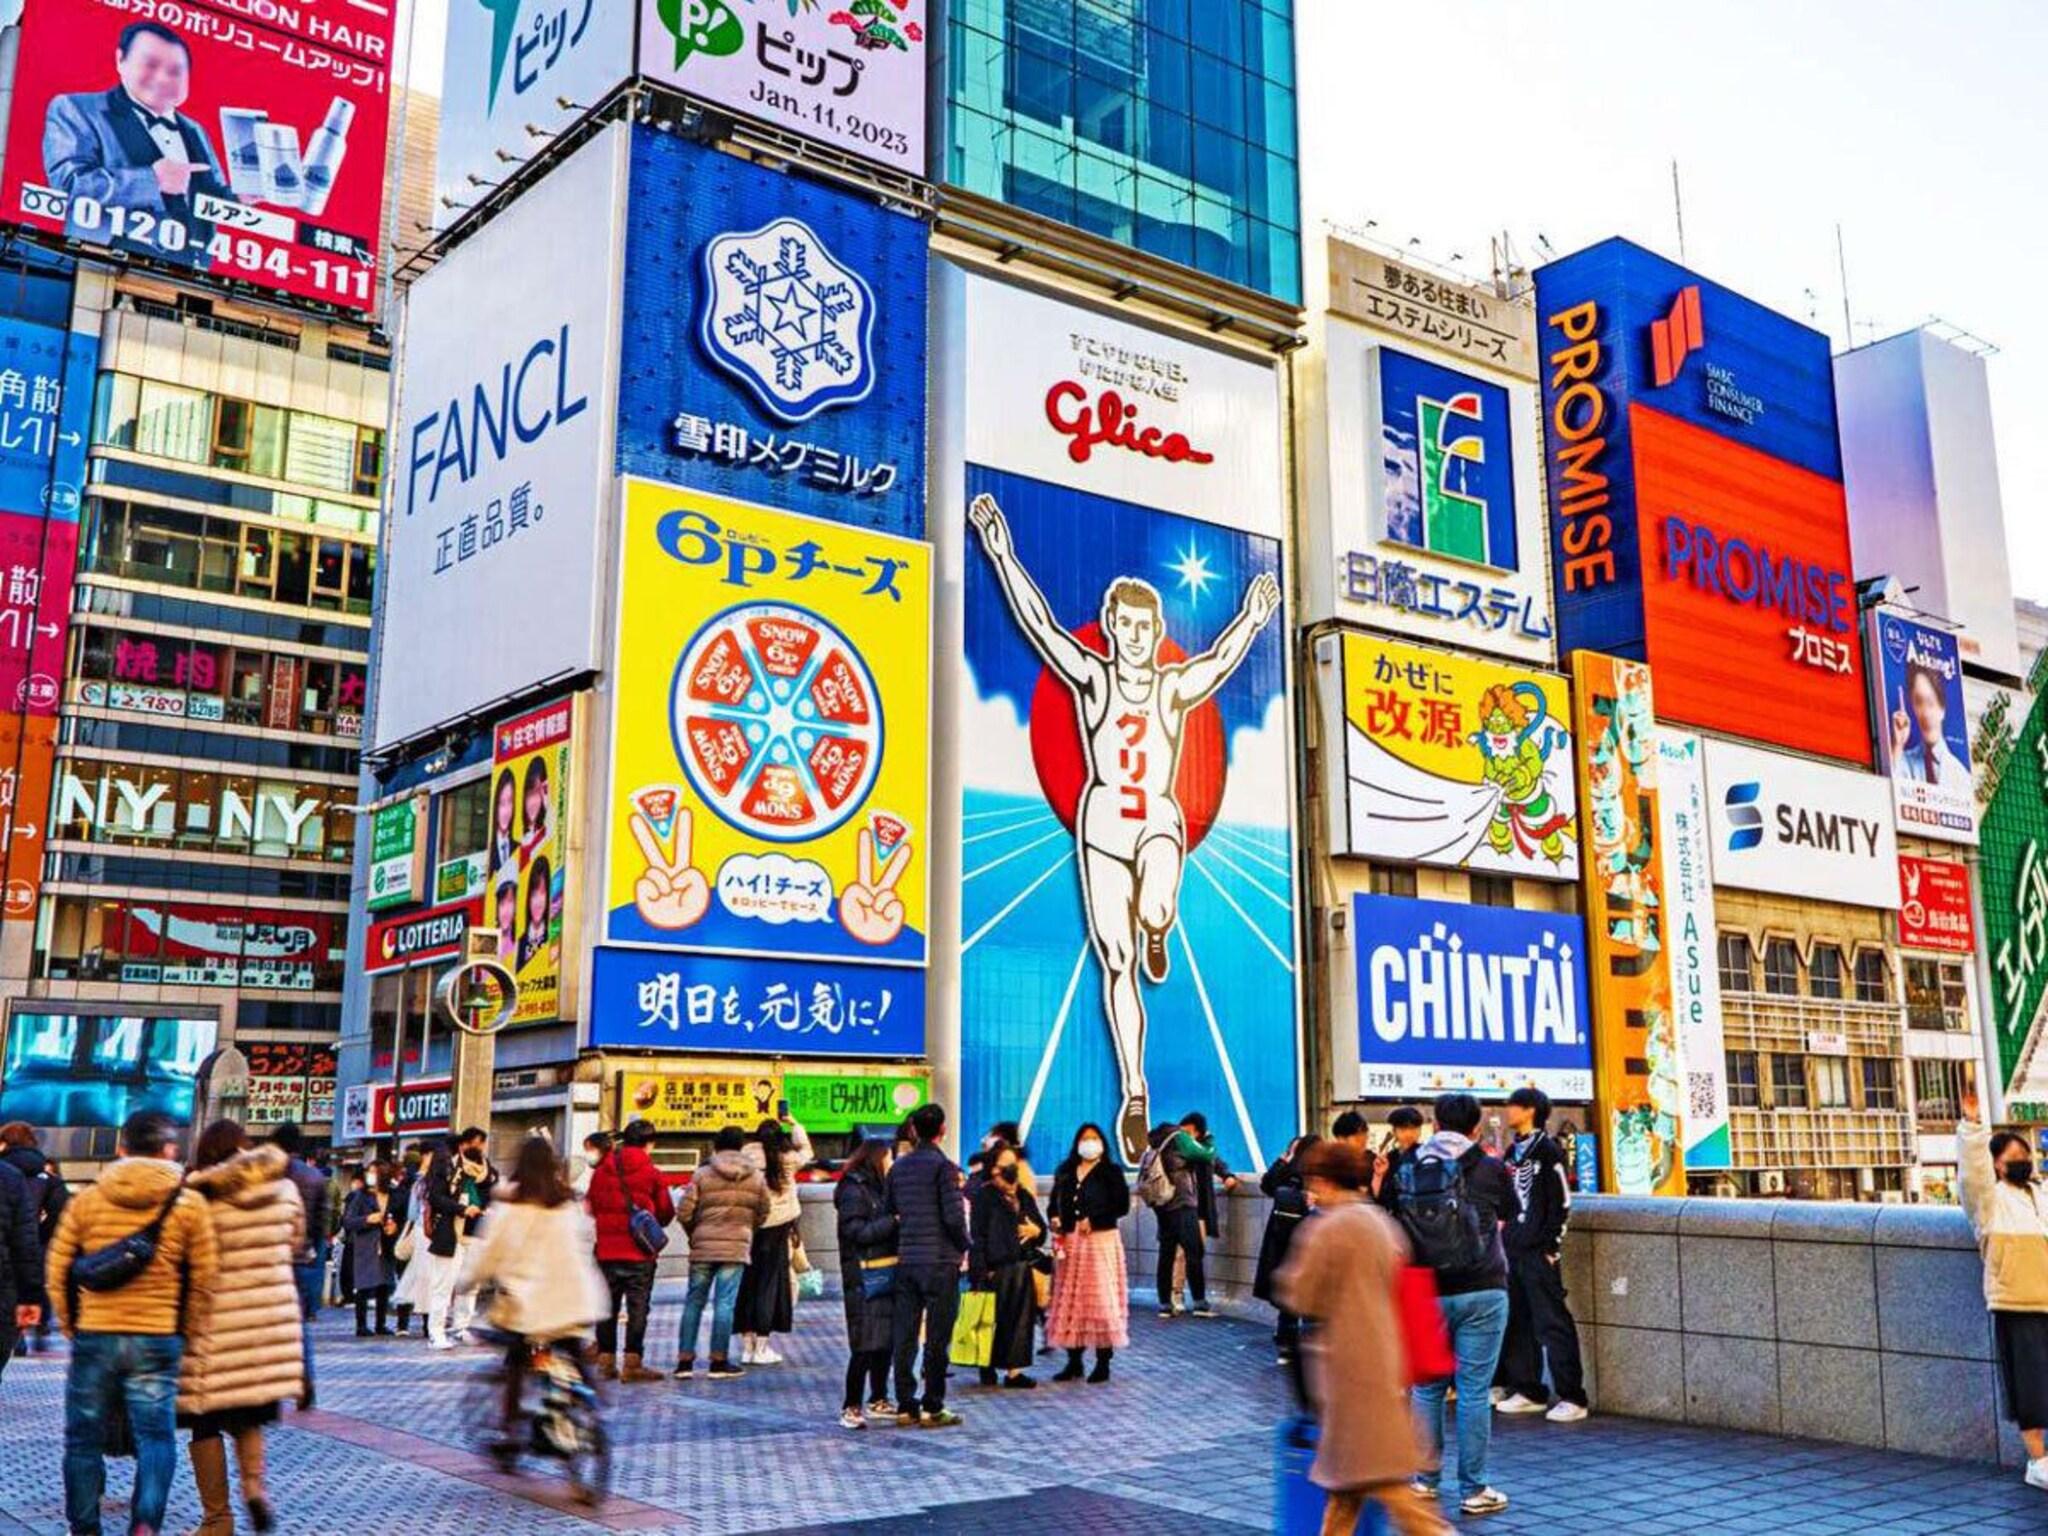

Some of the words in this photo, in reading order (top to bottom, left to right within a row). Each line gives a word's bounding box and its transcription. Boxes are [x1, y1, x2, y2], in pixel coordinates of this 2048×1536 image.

[309, 15, 386, 58] HAIR
[757, 21, 865, 96] ピップ
[749, 79, 806, 118] Jan.
[847, 116, 911, 156] 2023
[200, 202, 262, 228] ルアン
[74, 198, 370, 300] 0120-494-111
[1383, 263, 1488, 319] 夢ある住まい
[1367, 294, 1508, 362] エステムシリーズ
[407, 323, 588, 516] FANCL
[1045, 380, 1214, 463] Glico
[1708, 394, 1755, 426] FINANCE
[673, 412, 897, 493] 雪印メグミルク
[1548, 300, 1615, 594] PROMISE
[434, 480, 543, 575] 正直品質。
[1665, 516, 1851, 633] PROMISE
[760, 622, 809, 643] SNOW
[1788, 626, 1853, 675] プロミス
[695, 640, 730, 690] SNOW
[832, 663, 866, 713] SNOW
[1374, 653, 1453, 695] かぜに
[1365, 688, 1463, 748] 改源
[692, 729, 726, 782] SNOW
[831, 750, 863, 799] SNOW
[1116, 710, 1149, 820] グリコ
[58, 772, 171, 833] NY
[219, 788, 321, 846] NY
[753, 801, 802, 818] SNOW
[1776, 803, 1879, 857] SAMTY
[398, 914, 464, 951] LOTTERIA
